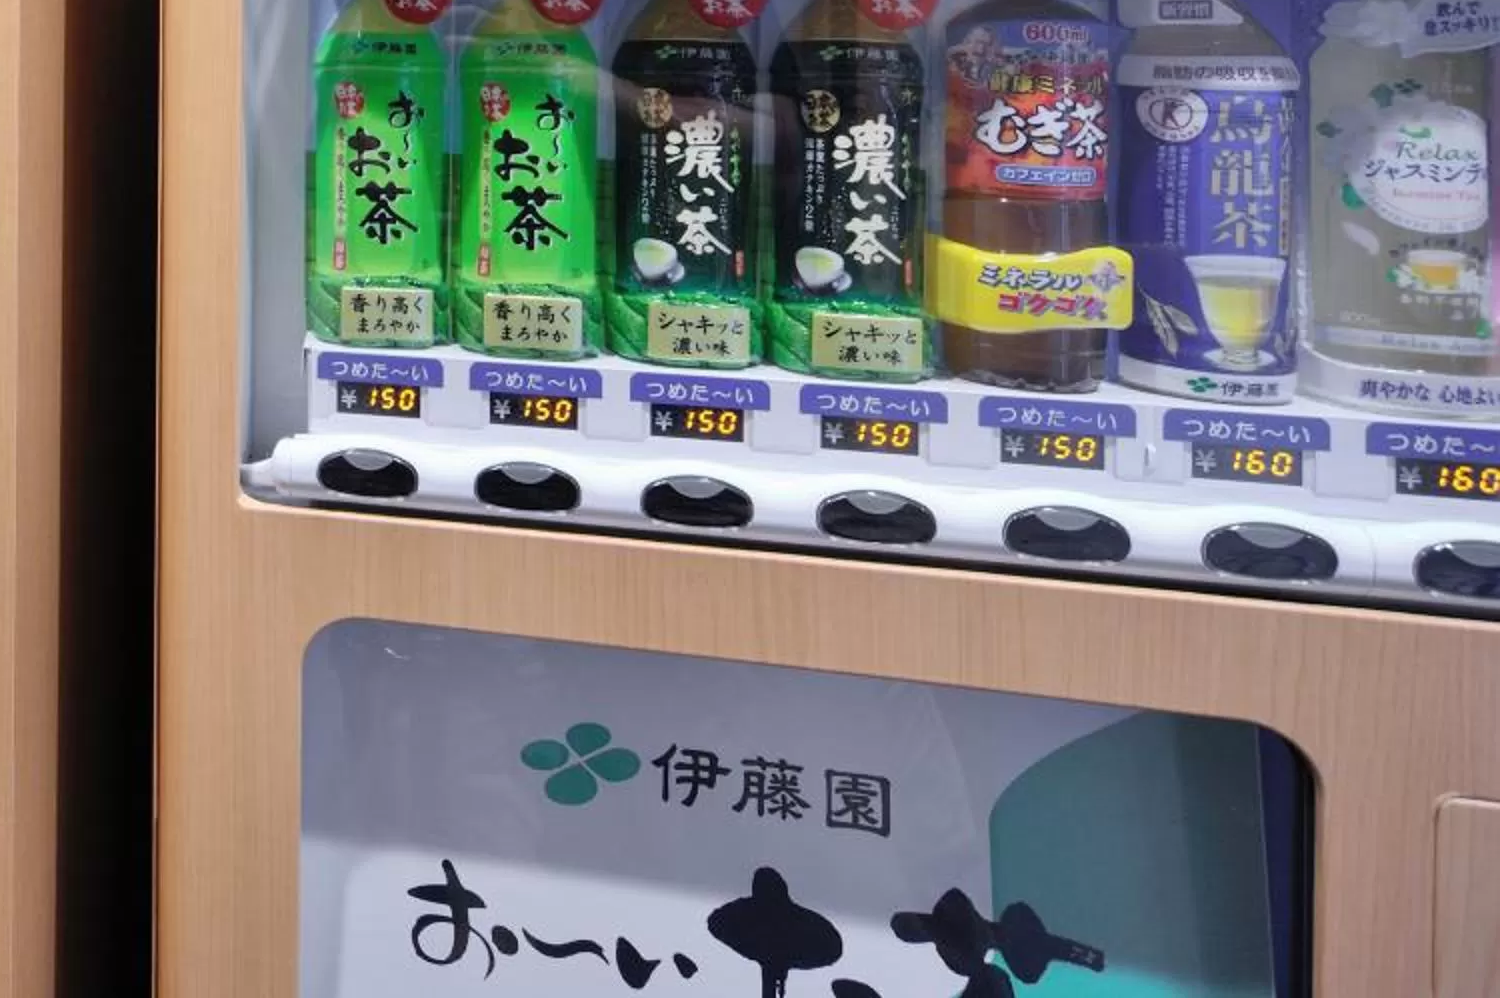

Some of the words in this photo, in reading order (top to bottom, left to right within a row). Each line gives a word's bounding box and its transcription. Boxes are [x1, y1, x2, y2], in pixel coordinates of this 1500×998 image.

[975, 97, 1109, 160] むぎ茶
[663, 108, 736, 256] 濃い茶
[1209, 94, 1275, 249] 烏龍茶
[347, 125, 420, 245] お茶
[493, 128, 570, 251] お茶
[831, 112, 908, 266] 濃い茶
[978, 262, 1084, 292] ミネラル
[350, 293, 426, 316] 香り高く
[492, 299, 573, 324] 香り高く
[356, 319, 421, 335] まろやか
[500, 326, 569, 344] まろやか
[658, 311, 745, 337] シャキッと
[821, 323, 919, 347] シャキッと
[671, 338, 734, 356] 濃い味
[837, 346, 903, 365] 濃い味
[331, 361, 429, 381] つめた〜い
[485, 370, 588, 393] つめた〜い
[340, 389, 357, 410] ¥
[367, 387, 416, 411] 150
[645, 381, 754, 404] つめた〜い
[493, 398, 512, 419] ¥
[522, 398, 573, 422] 150
[816, 393, 931, 418] つめた〜い
[654, 410, 673, 432] ¥
[683, 410, 738, 435] 150
[996, 406, 1118, 431] つめた〜い
[1183, 418, 1312, 444] つめた〜い
[823, 422, 844, 444] ¥
[854, 423, 912, 447] 150
[1005, 435, 1025, 458] ¥
[1038, 436, 1098, 463] 150
[1194, 449, 1218, 474] ¥
[1232, 450, 1294, 477] 160
[1399, 465, 1422, 491] ¥
[1437, 465, 1500, 495] 160
[650, 742, 892, 839] 伊藤園
